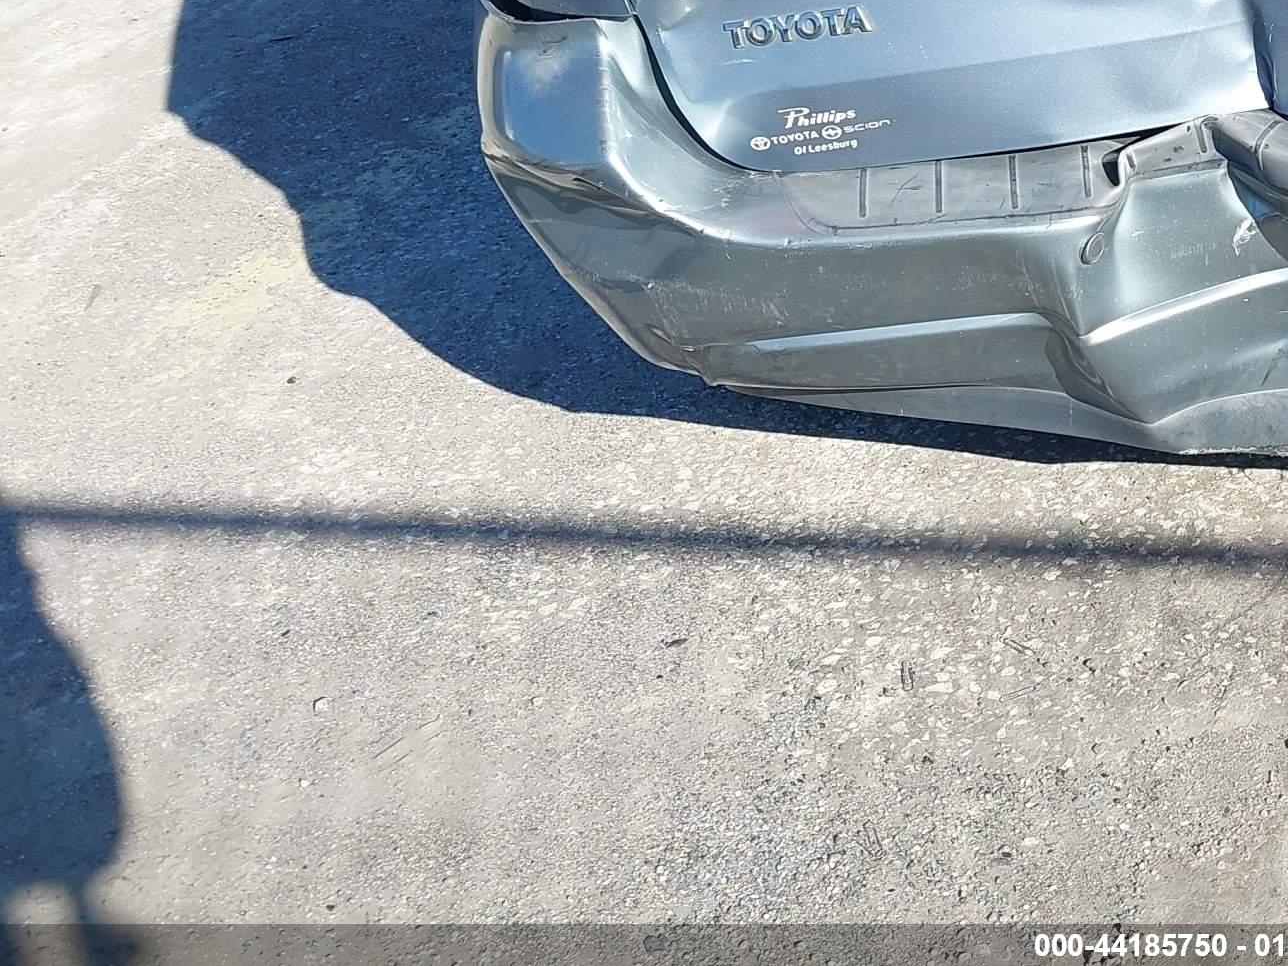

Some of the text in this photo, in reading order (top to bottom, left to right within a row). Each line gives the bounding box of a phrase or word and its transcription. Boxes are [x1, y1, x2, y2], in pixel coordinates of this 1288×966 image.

[722, 5, 873, 50] TOYOTA
[777, 107, 856, 129] Phillips
[770, 130, 819, 145] TOYOTA
[809, 138, 858, 153] Leesburg
